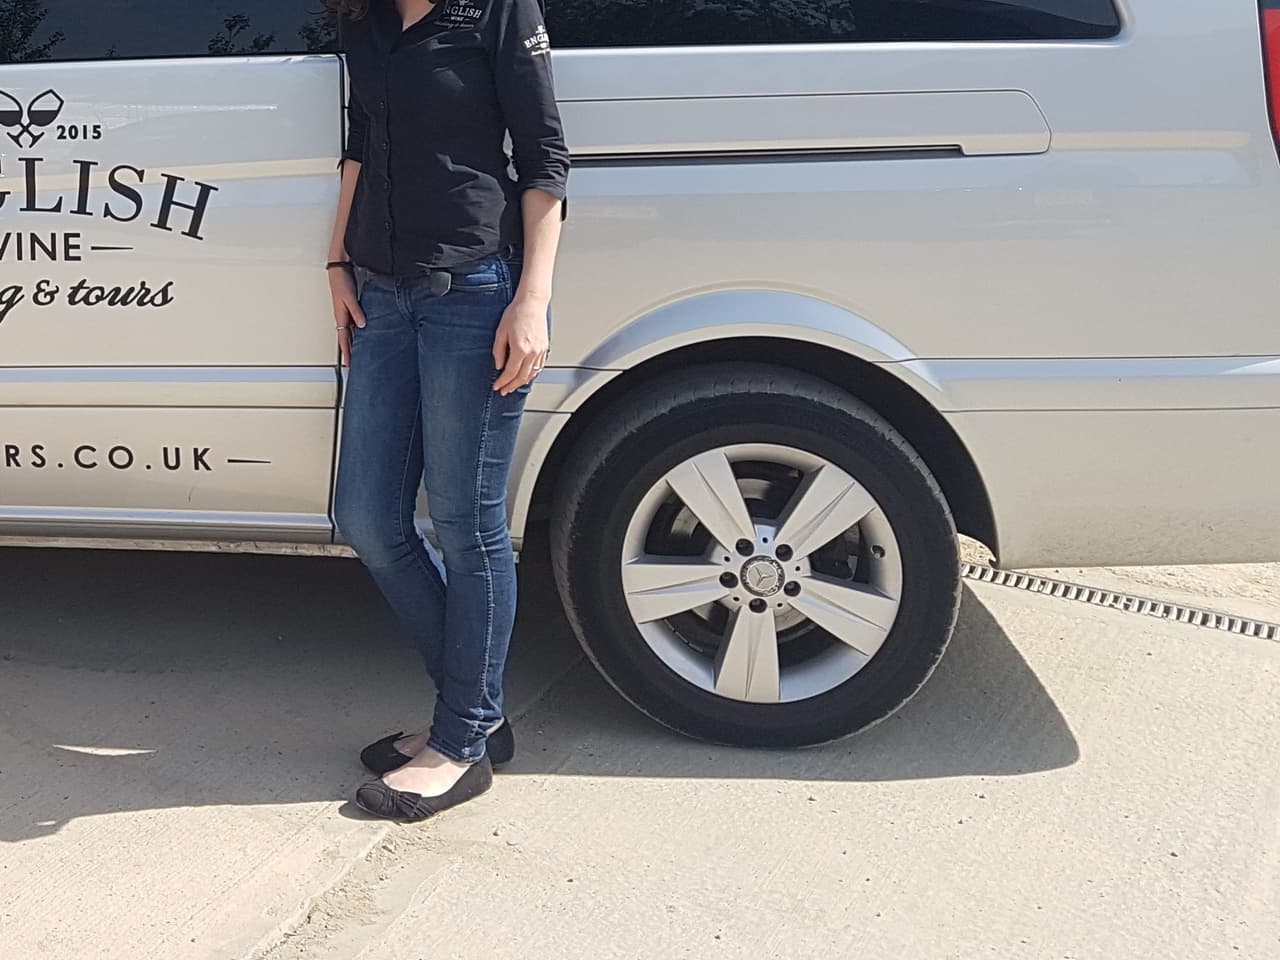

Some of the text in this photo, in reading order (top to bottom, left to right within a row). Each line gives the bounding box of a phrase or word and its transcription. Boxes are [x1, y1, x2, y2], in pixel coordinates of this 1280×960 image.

[56, 124, 102, 140] 2015
[32, 280, 59, 306] &
[67, 278, 174, 307] tours
